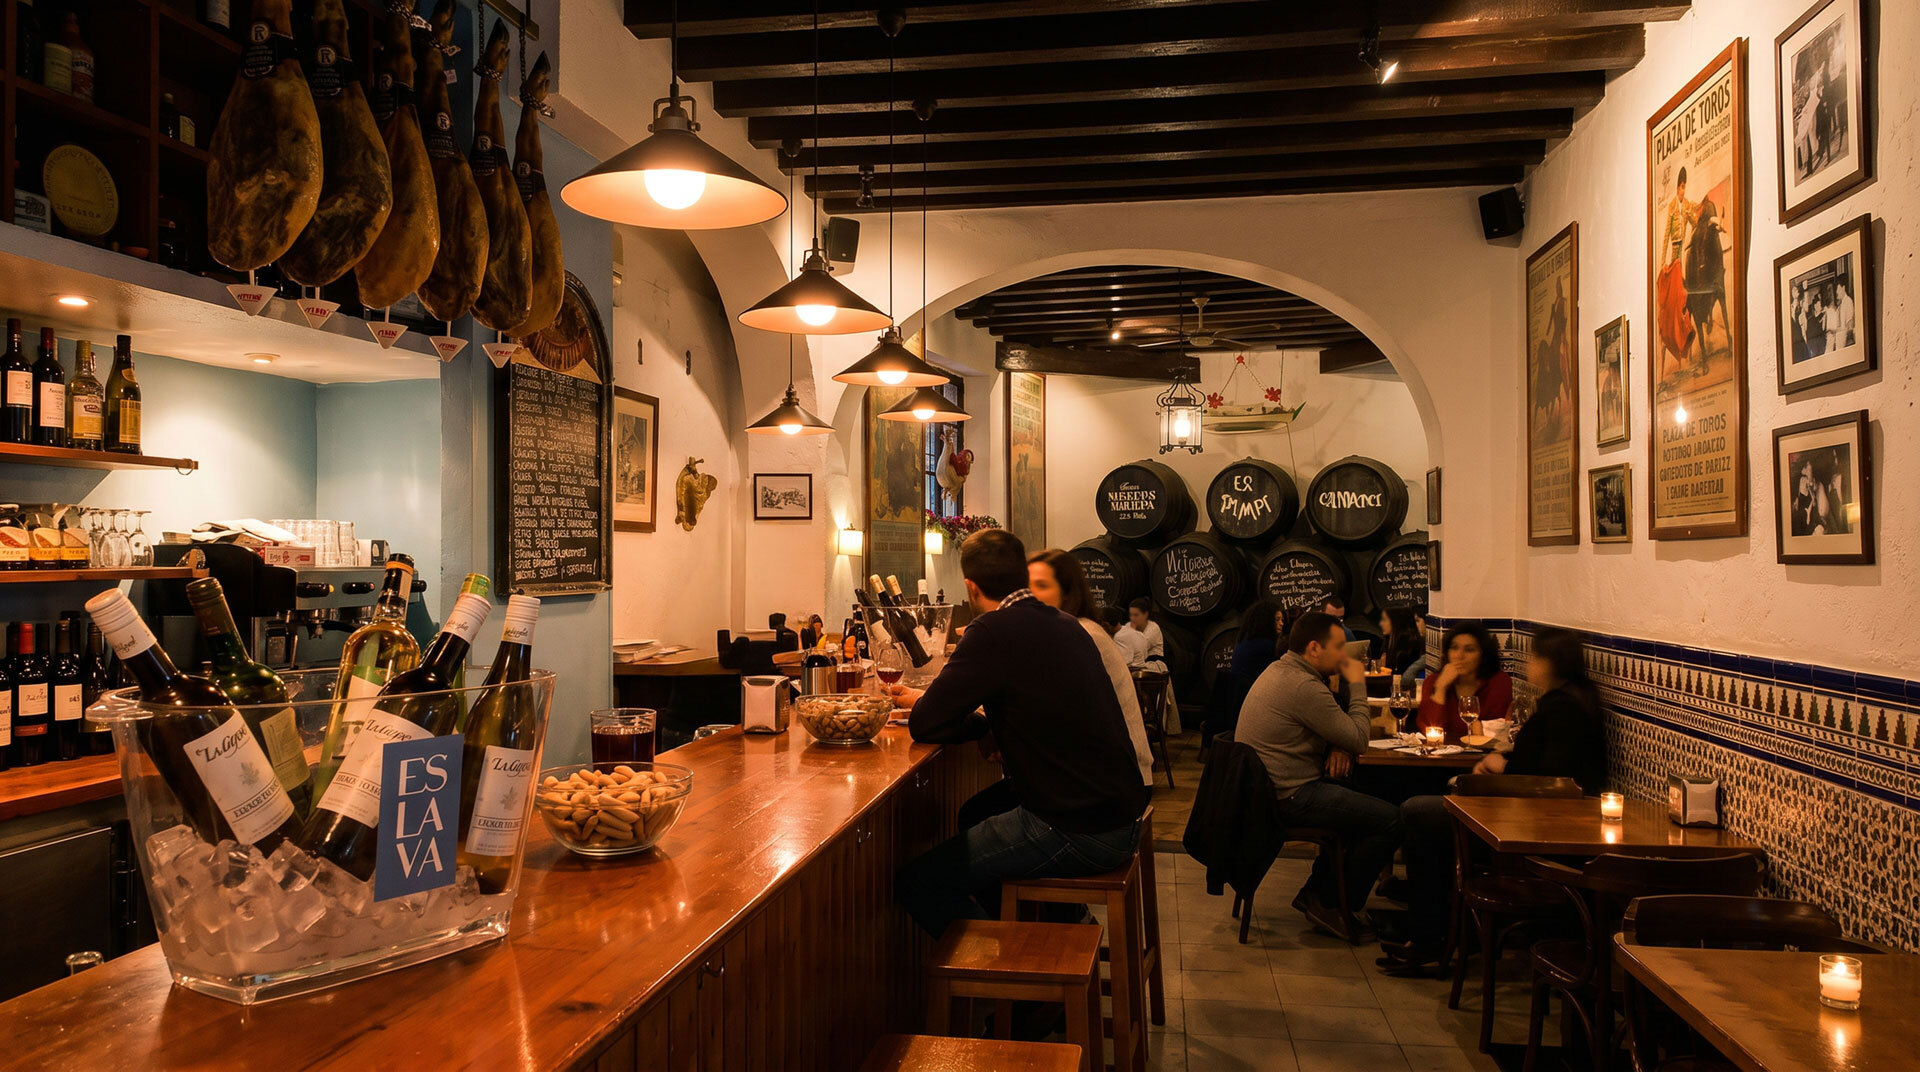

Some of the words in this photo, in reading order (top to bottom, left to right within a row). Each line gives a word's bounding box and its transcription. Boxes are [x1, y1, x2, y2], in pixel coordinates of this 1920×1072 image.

[1657, 120, 1682, 165] PLAZA
[1685, 108, 1697, 141] DE
[1699, 78, 1731, 129] TOROS
[1663, 426, 1683, 444] PLAZA
[1686, 421, 1696, 438] DE
[1698, 413, 1726, 435] TOROS
[1694, 461, 1704, 477] DE
[398, 753, 448, 797] ES
[395, 797, 444, 840] LA
[395, 836, 443, 879] VA
